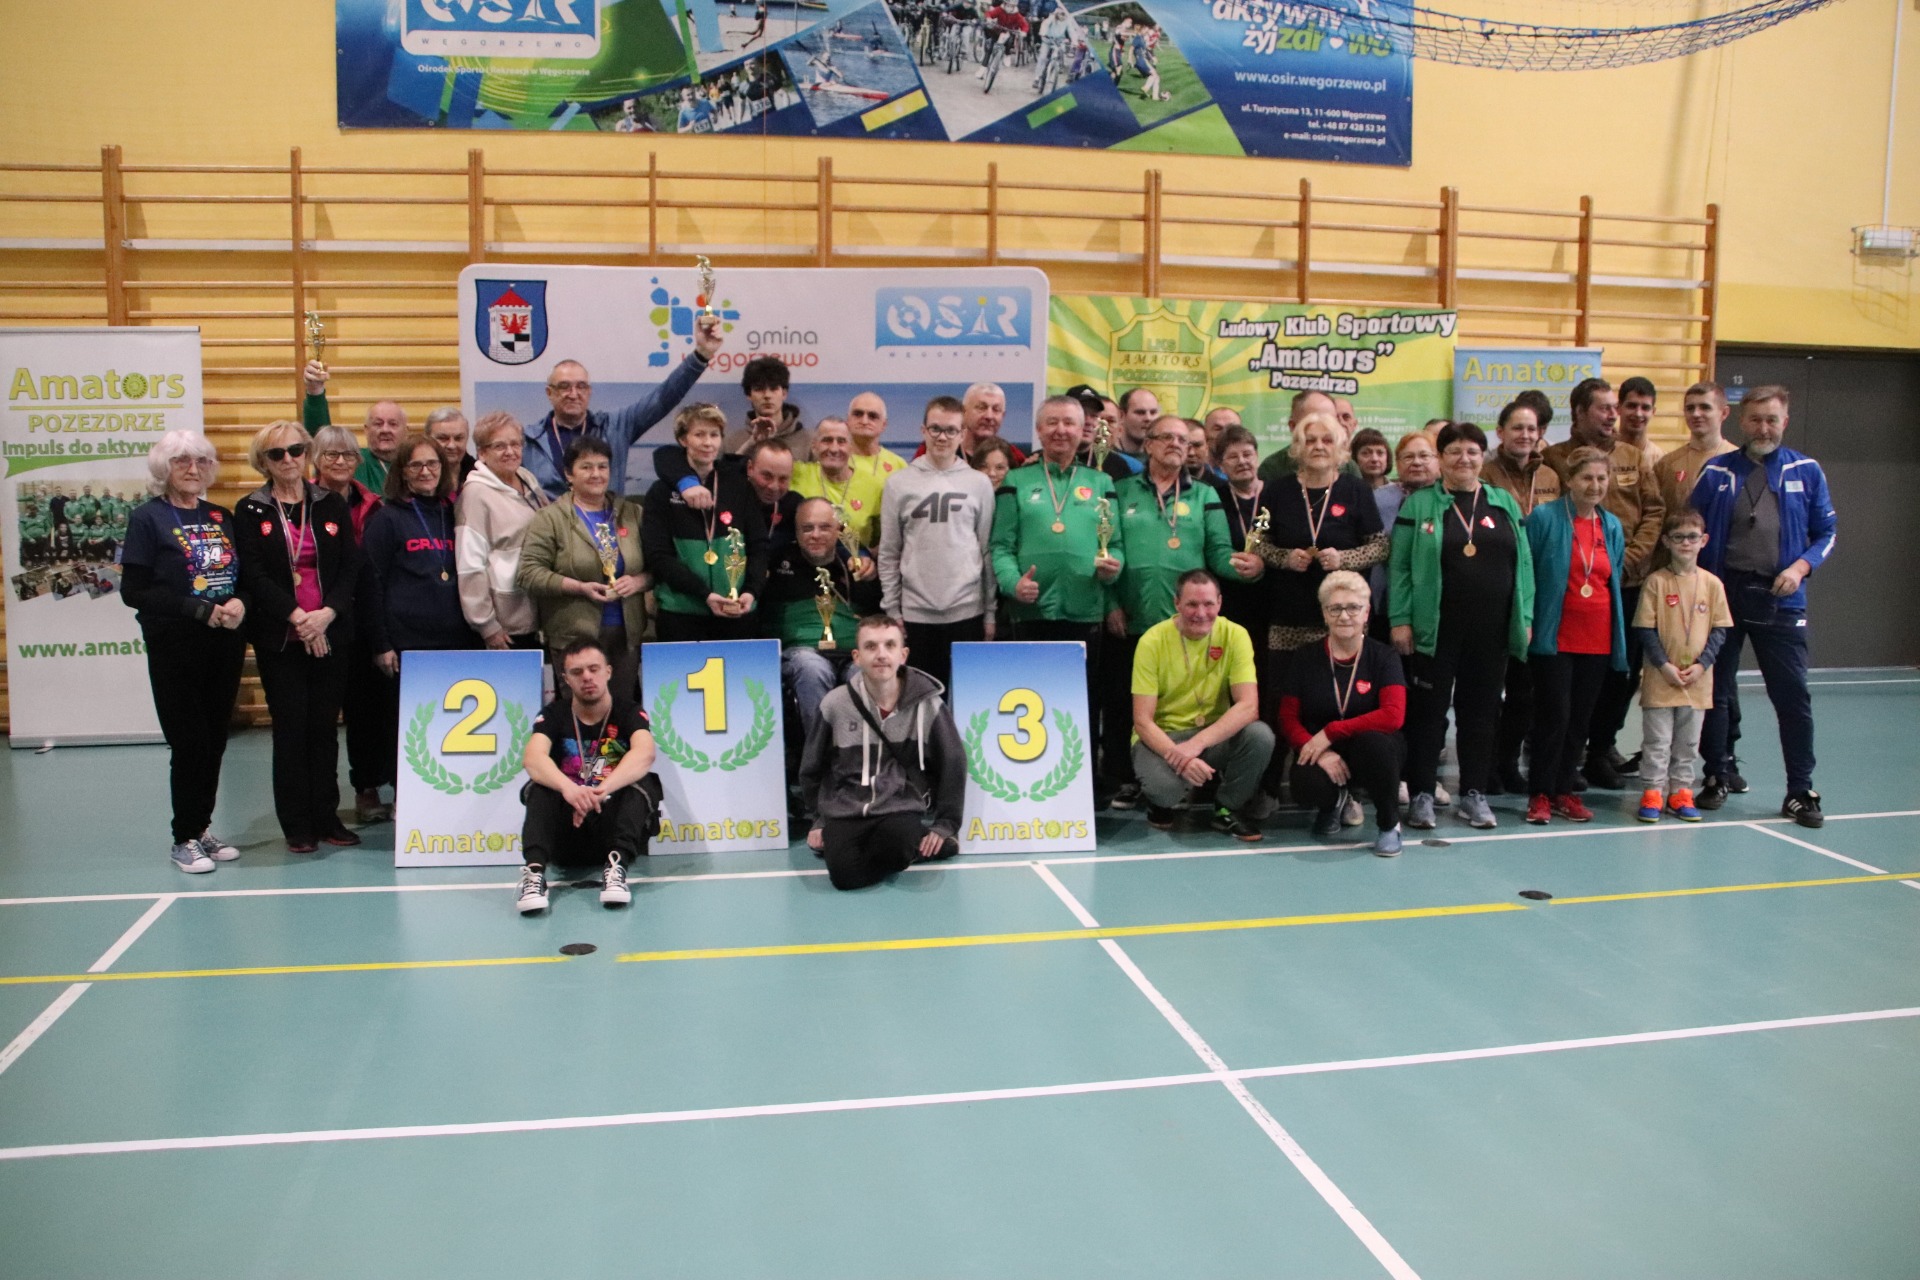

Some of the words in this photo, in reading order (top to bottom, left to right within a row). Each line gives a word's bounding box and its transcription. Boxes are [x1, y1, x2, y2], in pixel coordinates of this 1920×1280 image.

[417, 63, 453, 73] Ośrodek
[1234, 71, 1387, 93] www.osir.wegorzewo.pl
[1241, 104, 1252, 112] ul.
[1253, 103, 1299, 116] Turystyczna
[1301, 107, 1314, 117] 13,
[1314, 108, 1341, 118] 11-600
[1308, 120, 1321, 129] tel.
[1323, 121, 1338, 130] +48
[1338, 122, 1348, 130] 87
[1349, 122, 1363, 131] 428
[1365, 123, 1375, 131] 52
[1376, 124, 1386, 132] 34
[1283, 131, 1311, 141] e-mail:
[1312, 133, 1386, 147] osir@wegorzewo.pl
[747, 326, 818, 350] gmina
[1219, 319, 1280, 341] Ludowy
[1285, 315, 1330, 336] Klub
[1338, 312, 1457, 340] Sportowy
[1119, 353, 1202, 369] AMATORS
[1463, 356, 1594, 383] Amators
[9, 367, 186, 400] Amators
[1270, 371, 1358, 394] Pozezdrze
[1732, 375, 1743, 385] 13
[28, 412, 166, 433] POZEZDRZE
[2, 439, 65, 459] Impuls
[68, 438, 93, 454] do
[686, 657, 728, 734] 1
[441, 678, 498, 755] 2
[997, 687, 1049, 763] 3
[656, 818, 781, 843] Amators
[965, 817, 1089, 841] Amators
